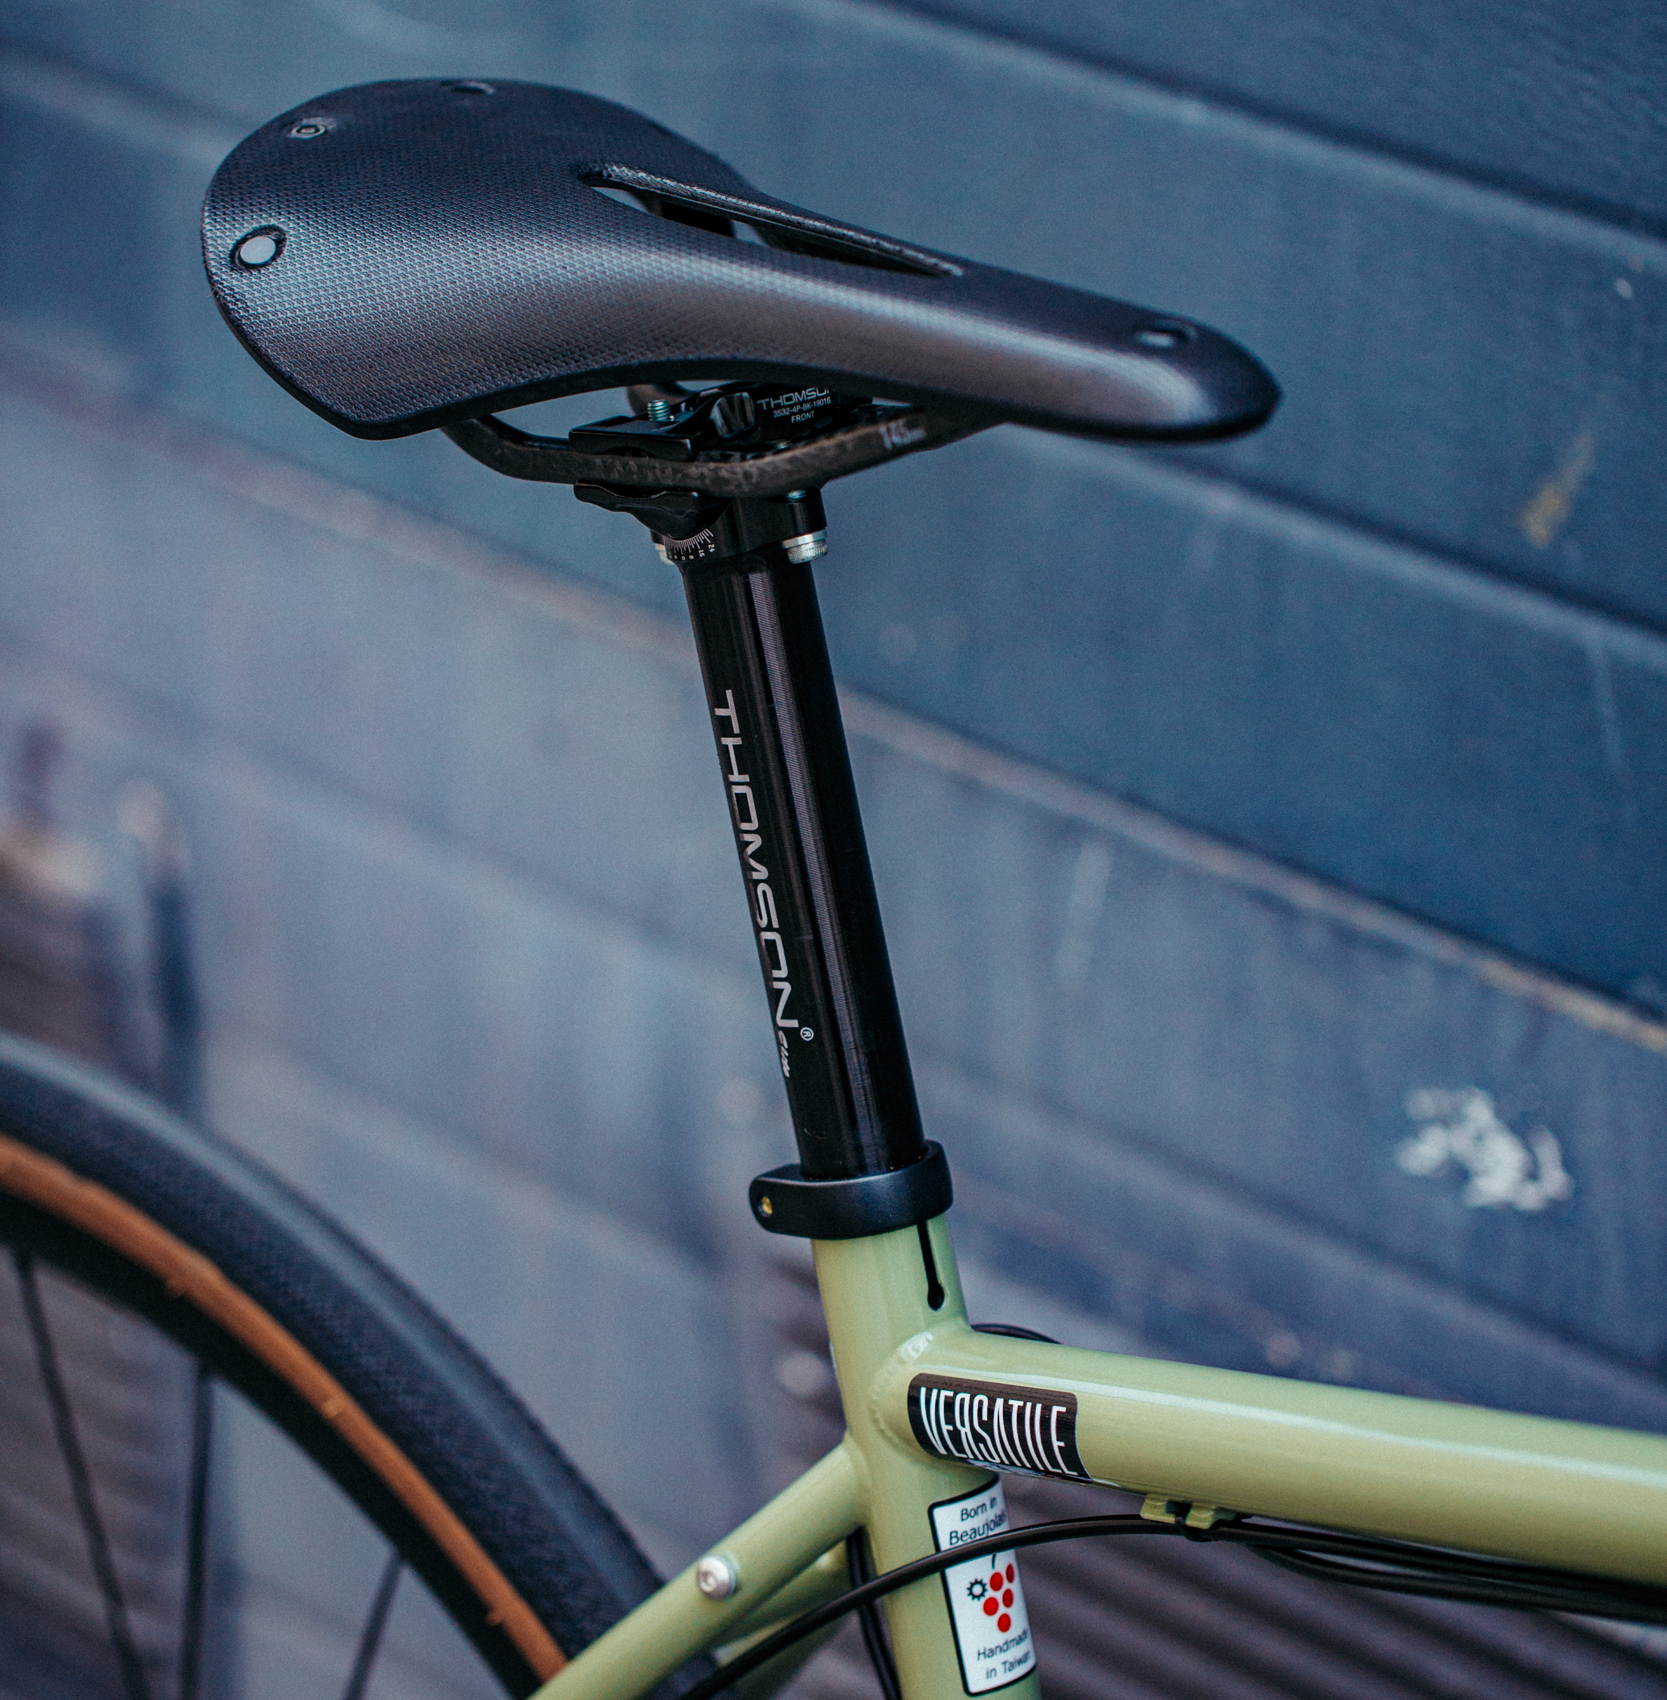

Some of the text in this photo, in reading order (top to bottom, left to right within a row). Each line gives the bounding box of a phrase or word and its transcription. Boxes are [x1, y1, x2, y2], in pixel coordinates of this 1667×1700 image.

[757, 387, 830, 411] THOMSO
[791, 410, 815, 424] FRONT
[714, 689, 799, 1028] THOMSON
[919, 1386, 1079, 1476] VERSATILE
[960, 1496, 998, 1522] Born in
[985, 1666, 998, 1680] in
